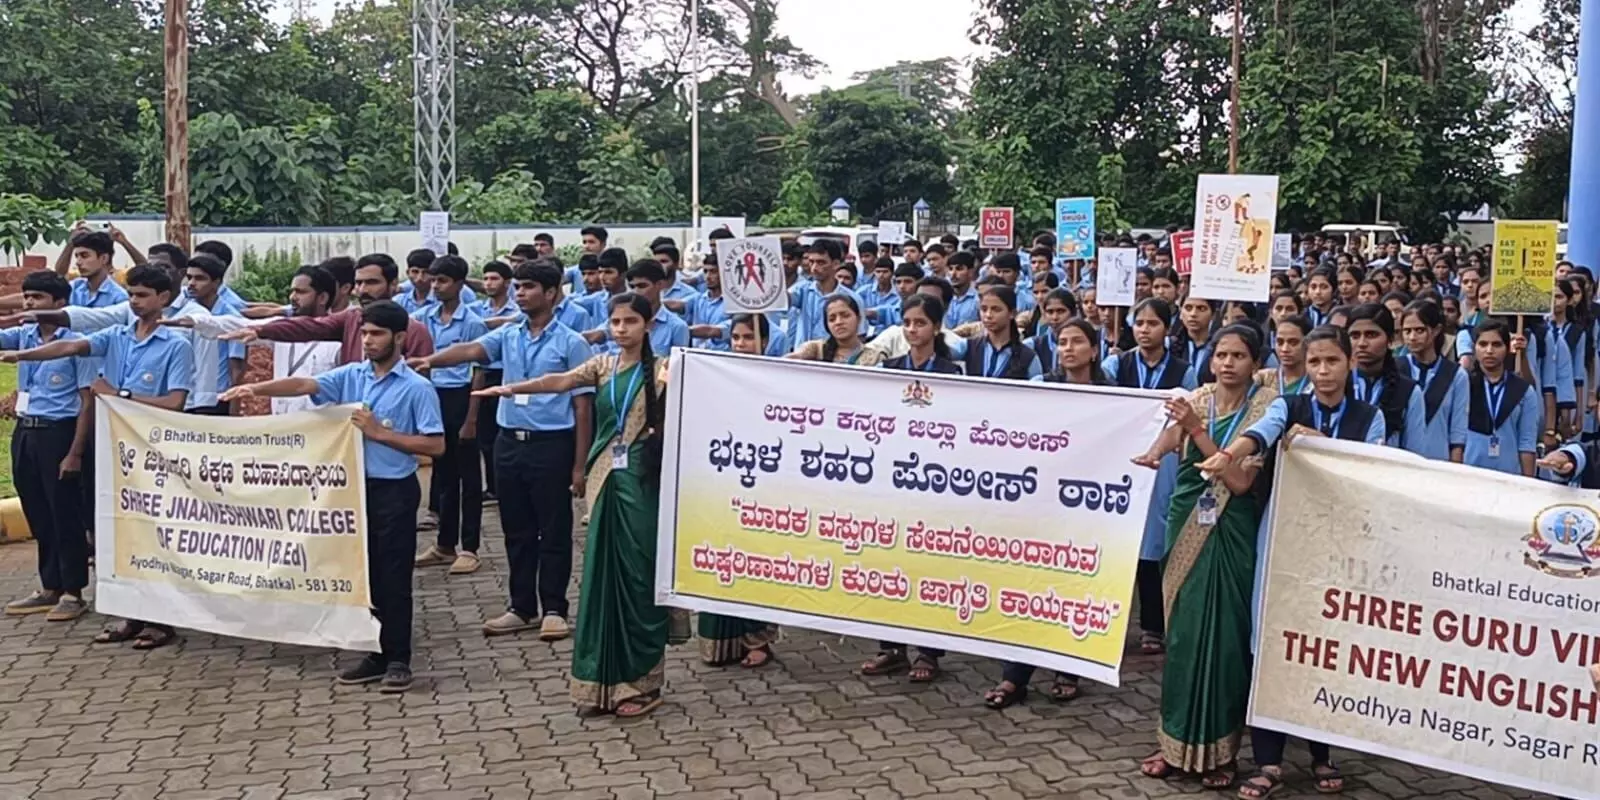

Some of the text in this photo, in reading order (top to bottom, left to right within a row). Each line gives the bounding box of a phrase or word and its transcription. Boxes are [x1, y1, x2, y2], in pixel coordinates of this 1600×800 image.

[986, 218, 1007, 230] NO
[1205, 194, 1213, 214] STAY
[724, 242, 778, 272] LOVE YOURSELF
[164, 430, 206, 443] Bhatkal
[264, 434, 305, 448] Trust(R)
[764, 403, 1070, 452] ಉತ್ತರ ಕನ್ನಡ ಜಿಲ್ಲಾ ಪೊಲೀಸ್
[118, 441, 136, 476] ಶ್ರೀ
[199, 454, 234, 496] ಶಿಕ್ಷಣ
[242, 456, 347, 501] ಮಹಾವಿದ್ಯಾಲಯ
[709, 431, 1132, 515] ಭಟ್ಕಳ ಶಹರ ಪೊಲೀಸ್ ಠಾಣೆ
[120, 488, 356, 534] SHREE JNAANESHWARI COLLEGE
[156, 527, 307, 572] OF EDUCATION (B.Ed)
[818, 511, 896, 550] ವಸ್ತುಗಳ
[906, 521, 1099, 572] ಸೇವನೆಯಿಂದಾಗುವ
[197, 568, 225, 584] Sagar
[227, 571, 253, 588] Road,
[255, 575, 296, 590] Bhatkal
[305, 579, 328, 592] 581
[331, 579, 352, 592] 320
[841, 563, 908, 597] ಕುರಿತು
[920, 577, 988, 620] ಜಾಗೃತಿ
[1432, 571, 1501, 597] Bhatkal
[1322, 588, 1423, 636] SHREE
[1433, 609, 1538, 657] GURU
[1283, 630, 1598, 724] THE NEW ENGLISH
[1313, 686, 1412, 726] Ayodhya
[1420, 708, 1495, 747] Nagar,
[1503, 726, 1574, 760] Sagar
